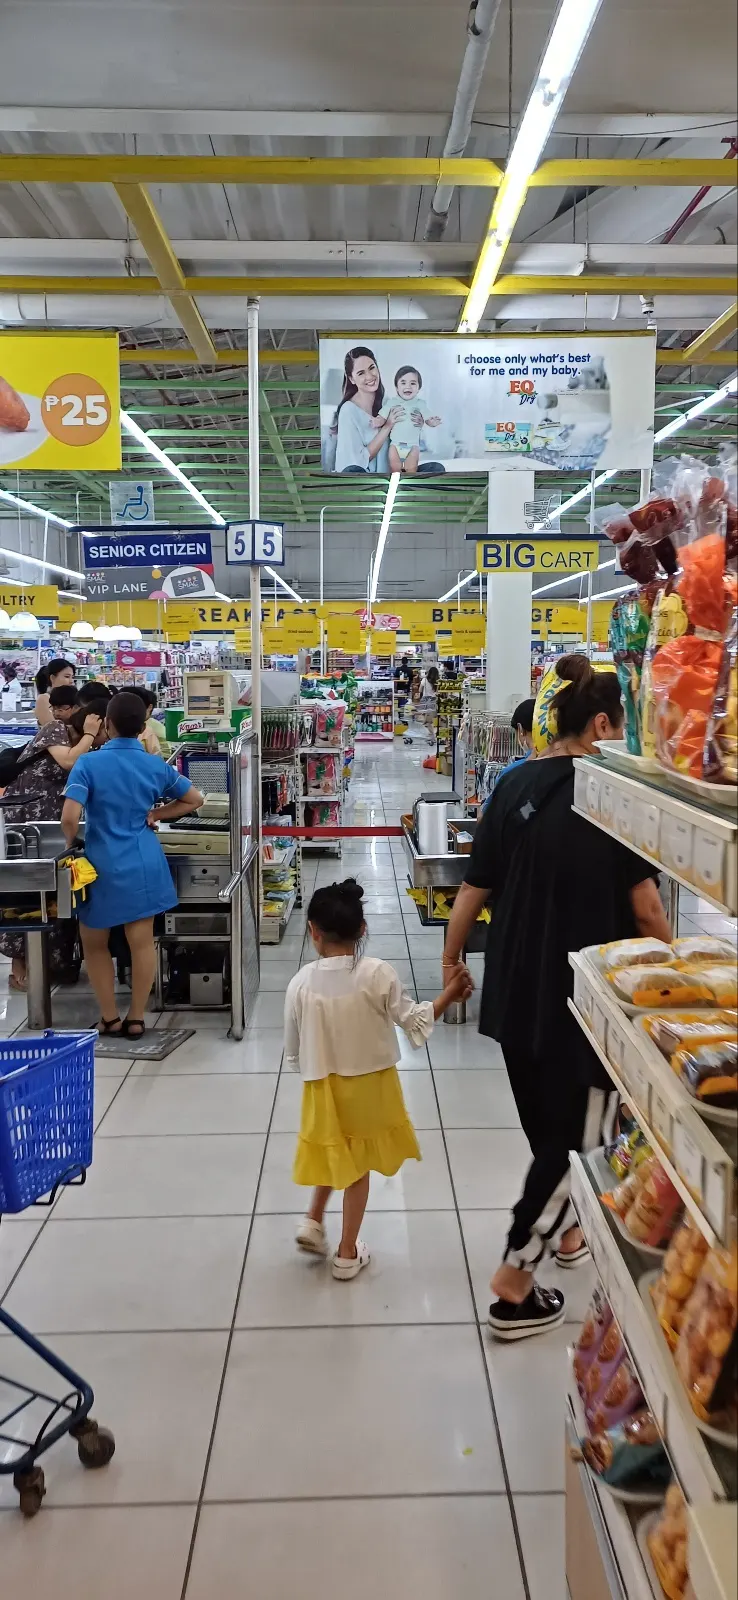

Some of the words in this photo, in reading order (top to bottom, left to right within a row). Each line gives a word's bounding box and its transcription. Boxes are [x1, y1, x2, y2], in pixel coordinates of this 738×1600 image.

[457, 354, 461, 364] I
[464, 354, 501, 364] choose
[504, 354, 527, 366] only
[530, 353, 565, 364] what's
[568, 353, 591, 363] best
[469, 366, 486, 376] for
[489, 367, 506, 376] me
[508, 366, 529, 376] and
[532, 367, 549, 378] my
[551, 365, 581, 378] baby.
[509, 380, 535, 395] EQ
[519, 394, 536, 406] Dry
[496, 421, 516, 433] EQ
[234, 530, 246, 556] 5
[262, 531, 276, 557] 5
[89, 544, 146, 559] SENIOR
[149, 542, 207, 557] CITIZEN
[483, 543, 536, 568] BIG
[540, 551, 595, 568] CART
[88, 584, 109, 595] VIP
[113, 582, 148, 594] LANE
[0, 595, 36, 606] LTRY
